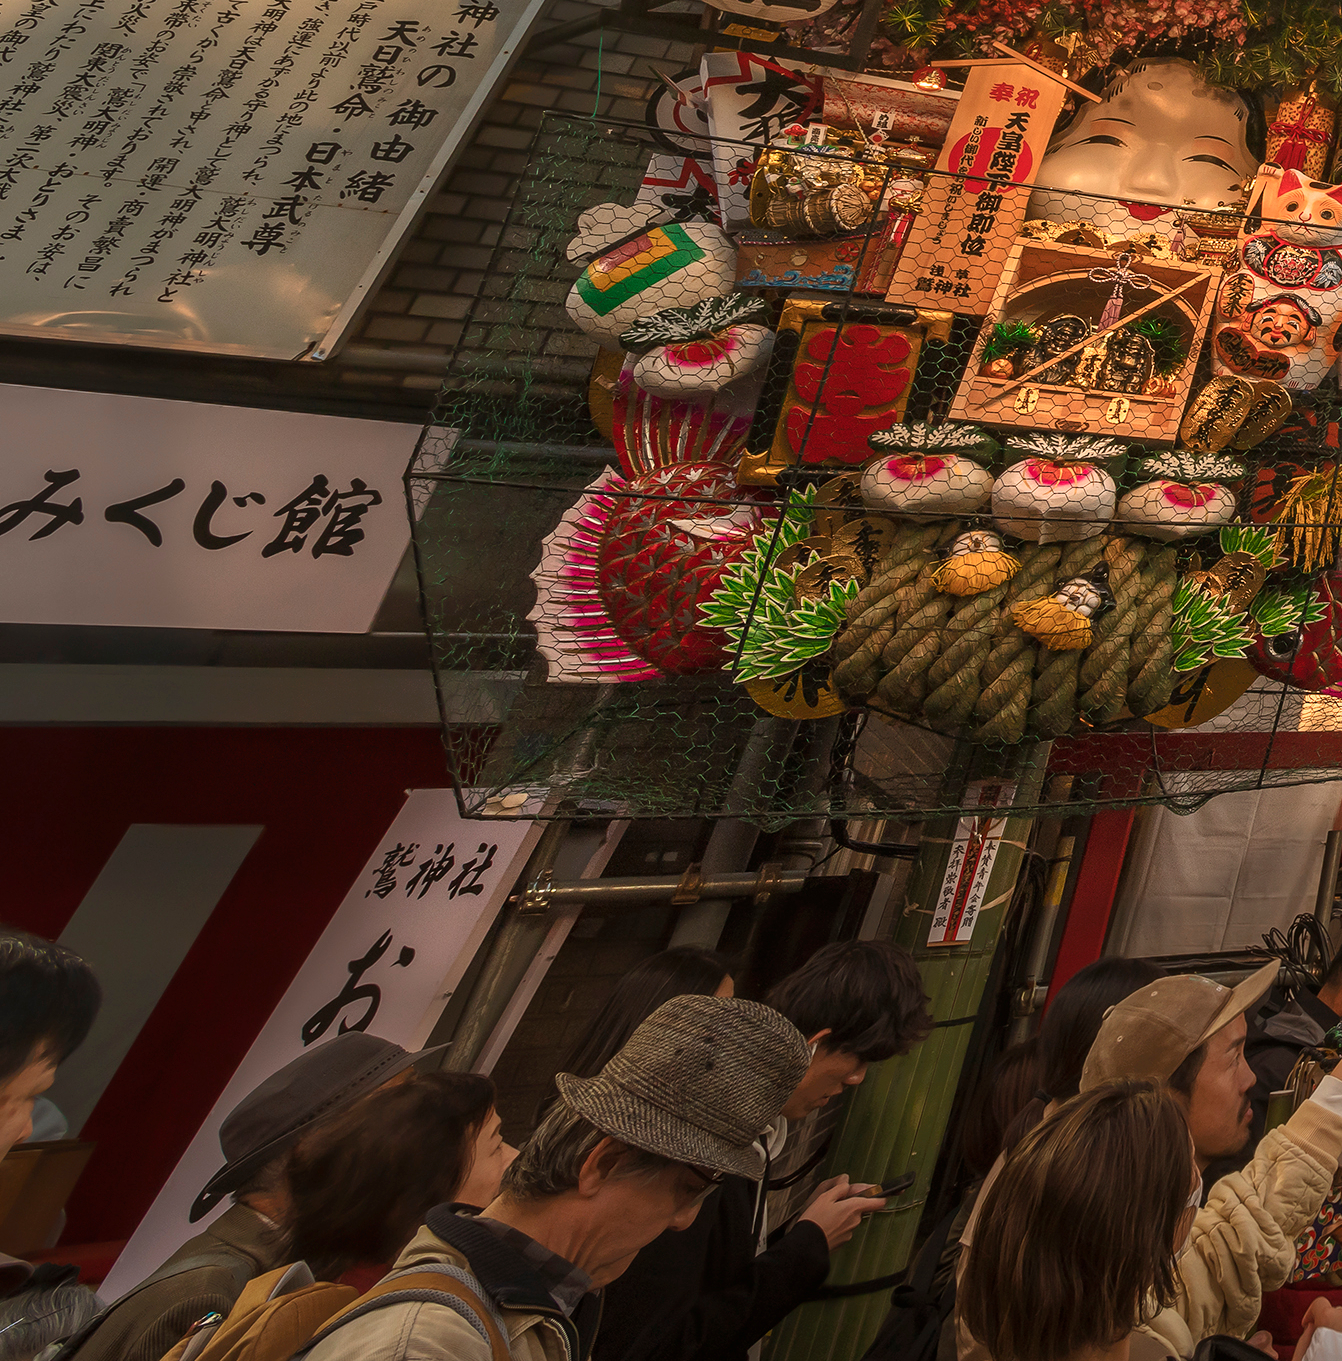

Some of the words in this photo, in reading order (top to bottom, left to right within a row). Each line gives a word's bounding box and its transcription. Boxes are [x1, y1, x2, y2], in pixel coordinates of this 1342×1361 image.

[989, 82, 1040, 110] 奉祝
[960, 111, 1031, 257] 天皇陛下御即位
[0, 468, 382, 559] みくじ館
[365, 841, 500, 902] 鷲神社
